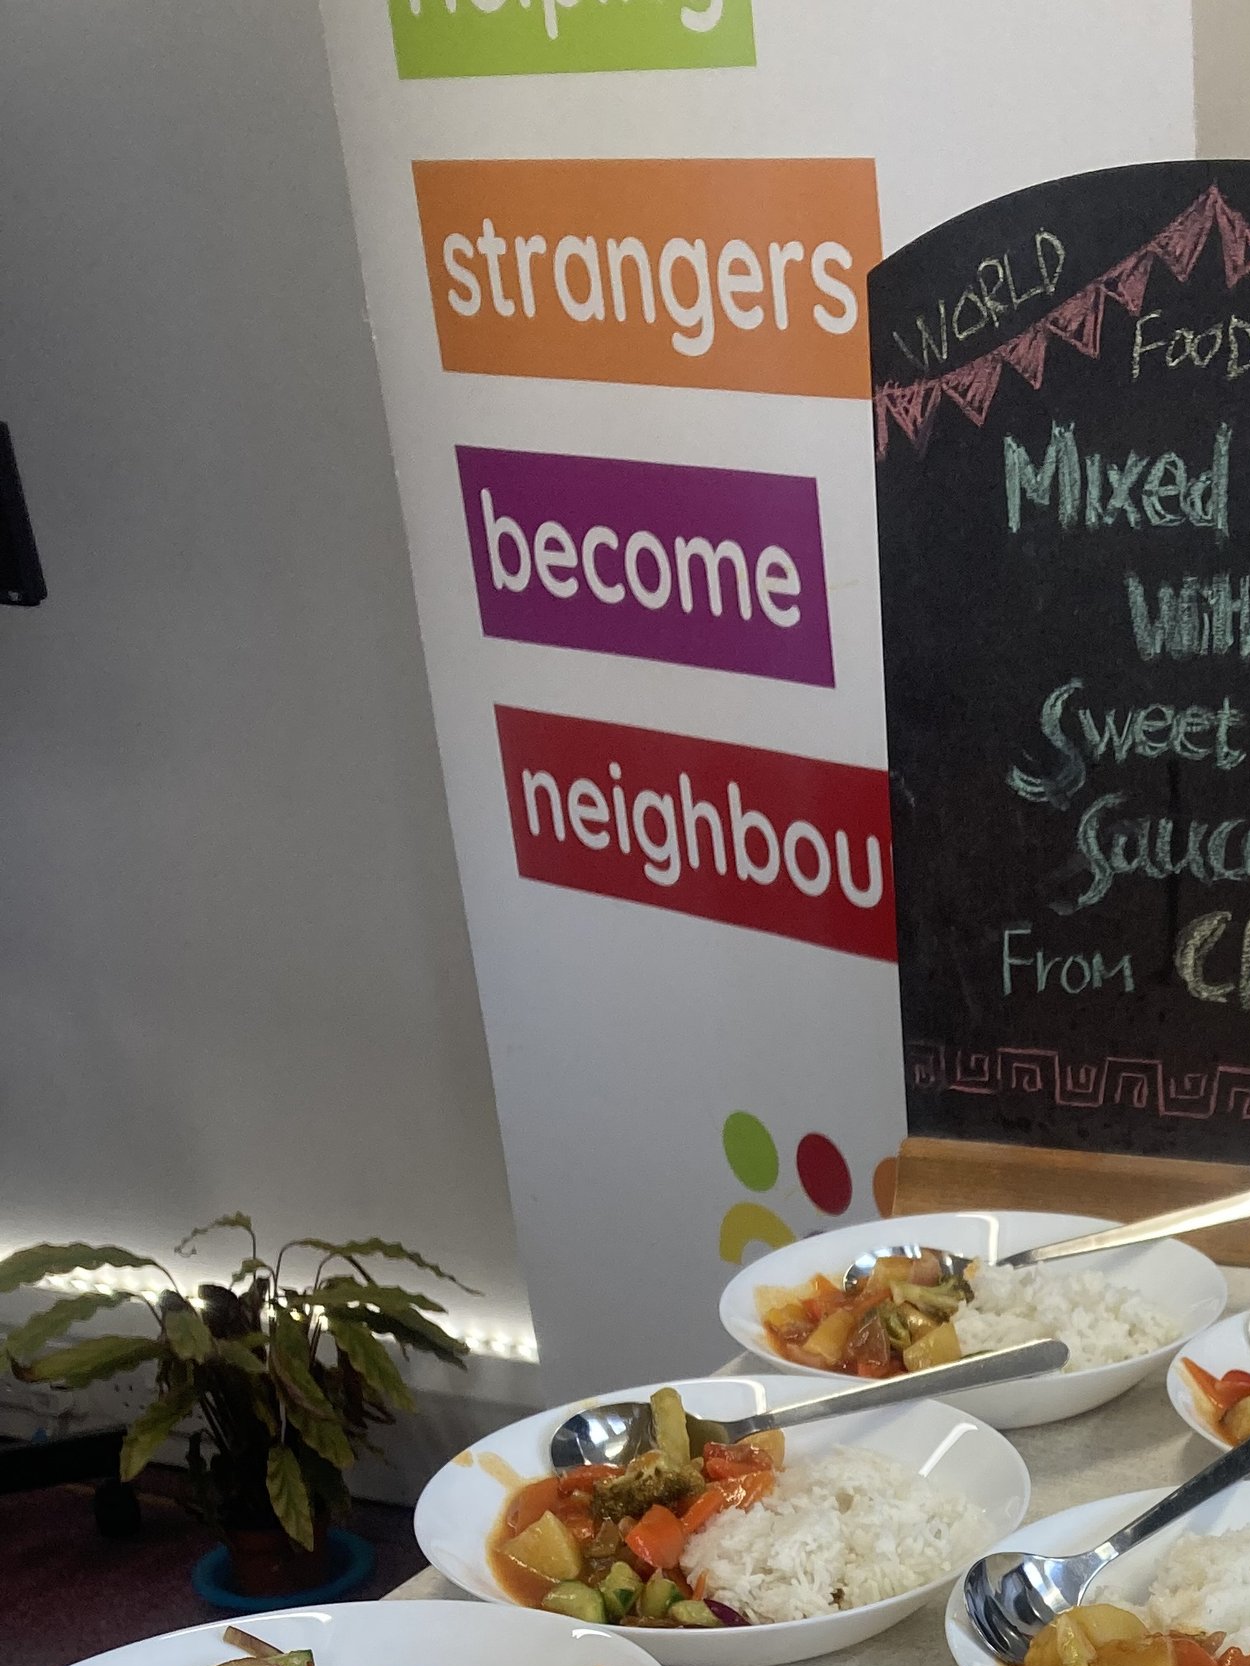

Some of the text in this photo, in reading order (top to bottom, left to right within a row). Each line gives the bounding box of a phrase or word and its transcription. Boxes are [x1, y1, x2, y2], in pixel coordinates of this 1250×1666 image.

[443, 219, 859, 357] strangers
[892, 227, 1066, 371] WORLD
[480, 488, 801, 628] become
[1006, 678, 1248, 804] Sweet
[522, 762, 892, 910] neighbou
[1002, 926, 1136, 997] From
